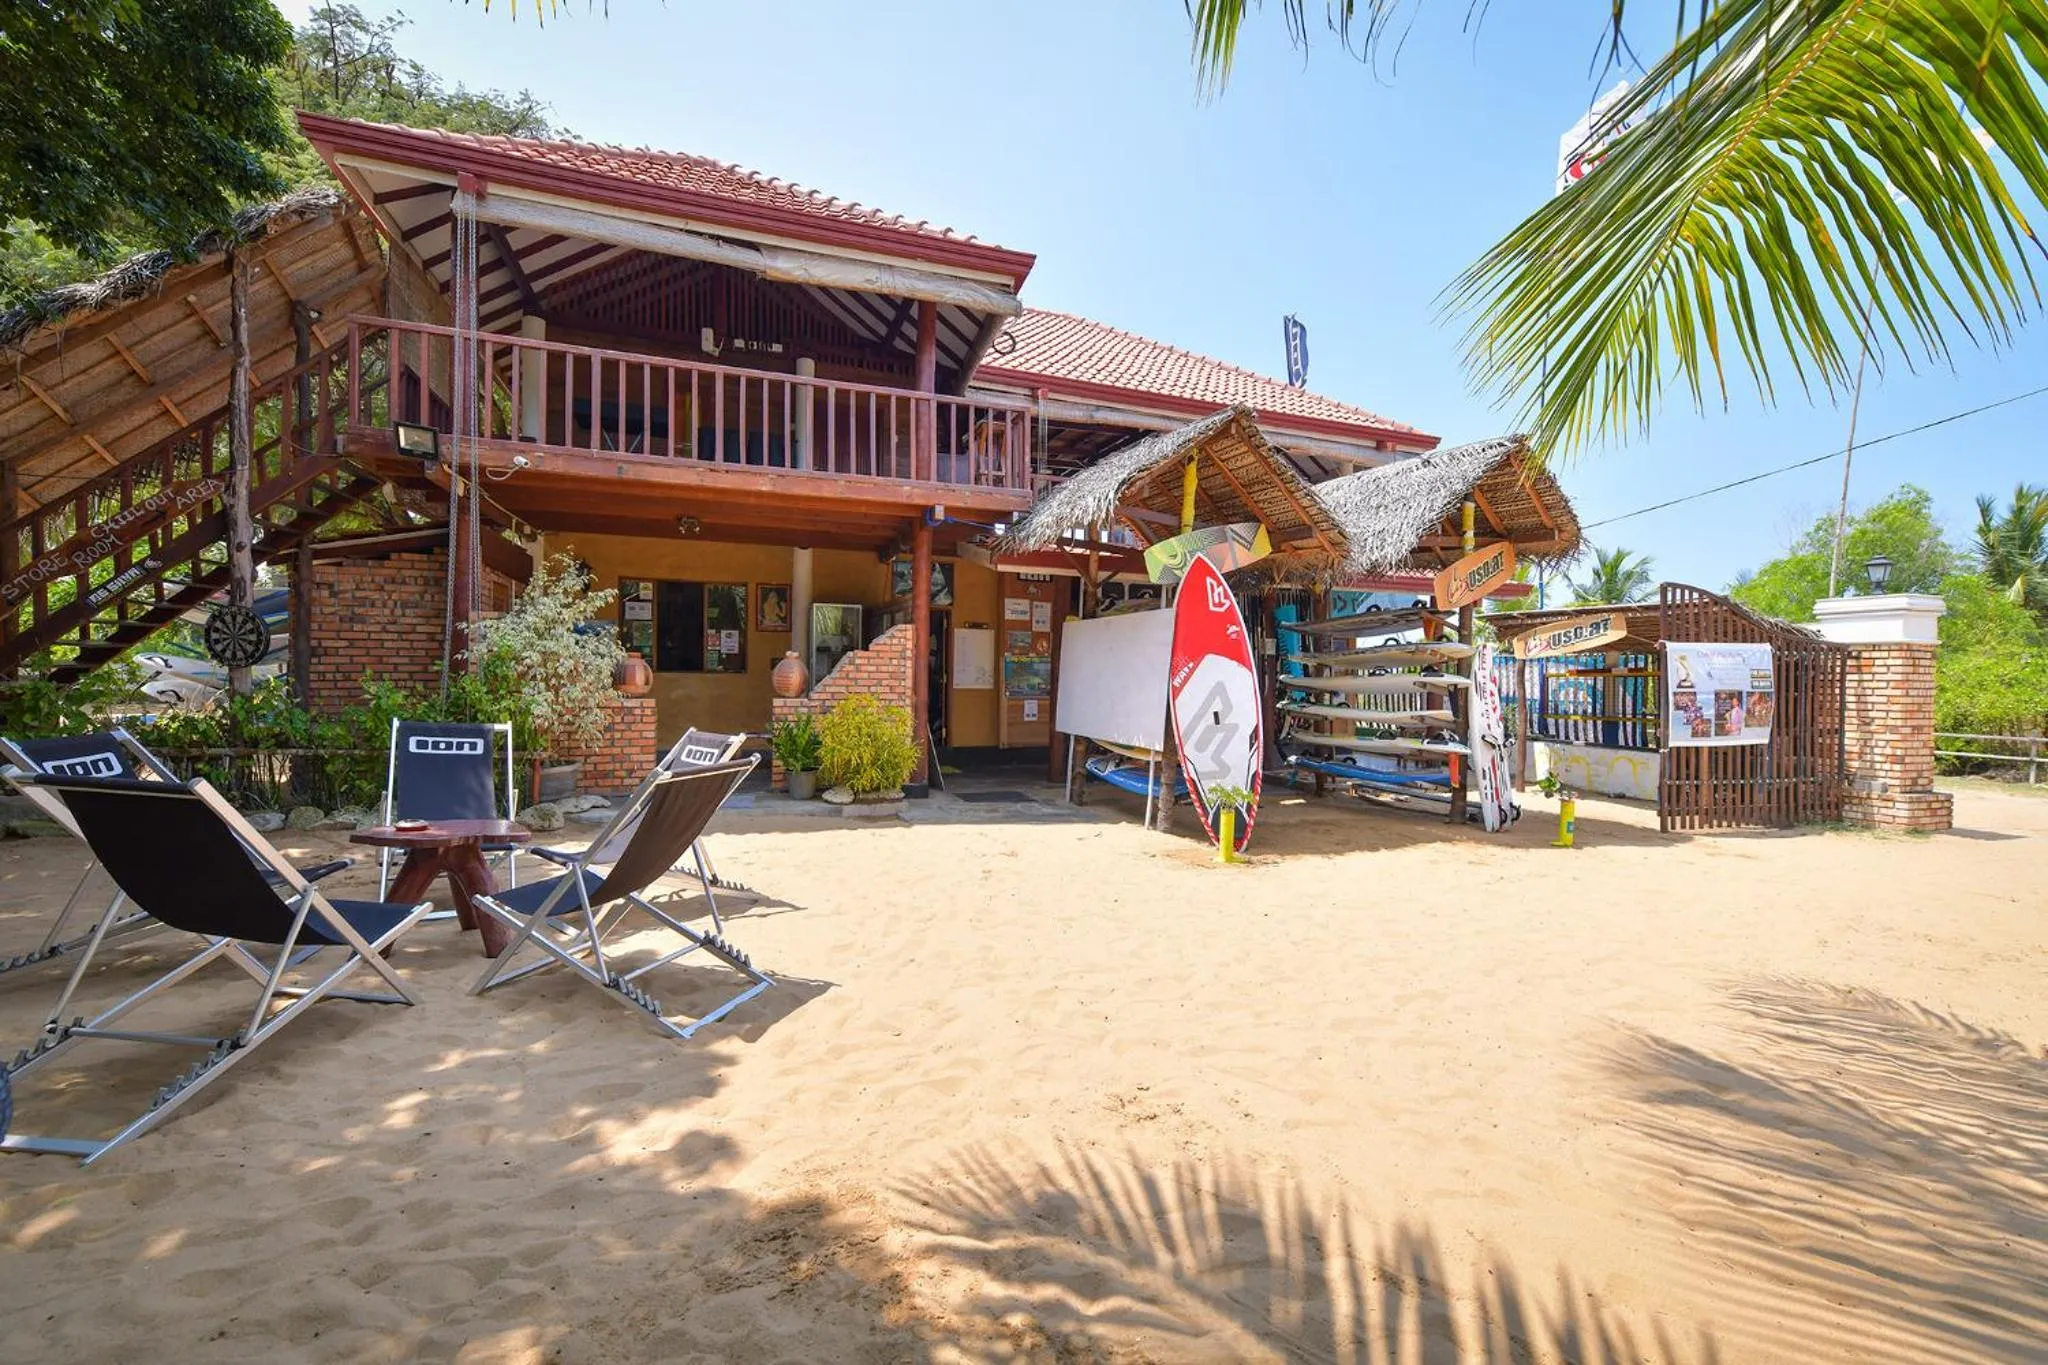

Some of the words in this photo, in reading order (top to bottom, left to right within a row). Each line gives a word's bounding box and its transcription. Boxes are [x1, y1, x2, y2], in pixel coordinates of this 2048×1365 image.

[145, 487, 176, 511] OUT
[176, 478, 224, 509] AREA
[72, 535, 123, 569] ROOM
[1, 554, 69, 599] STORE
